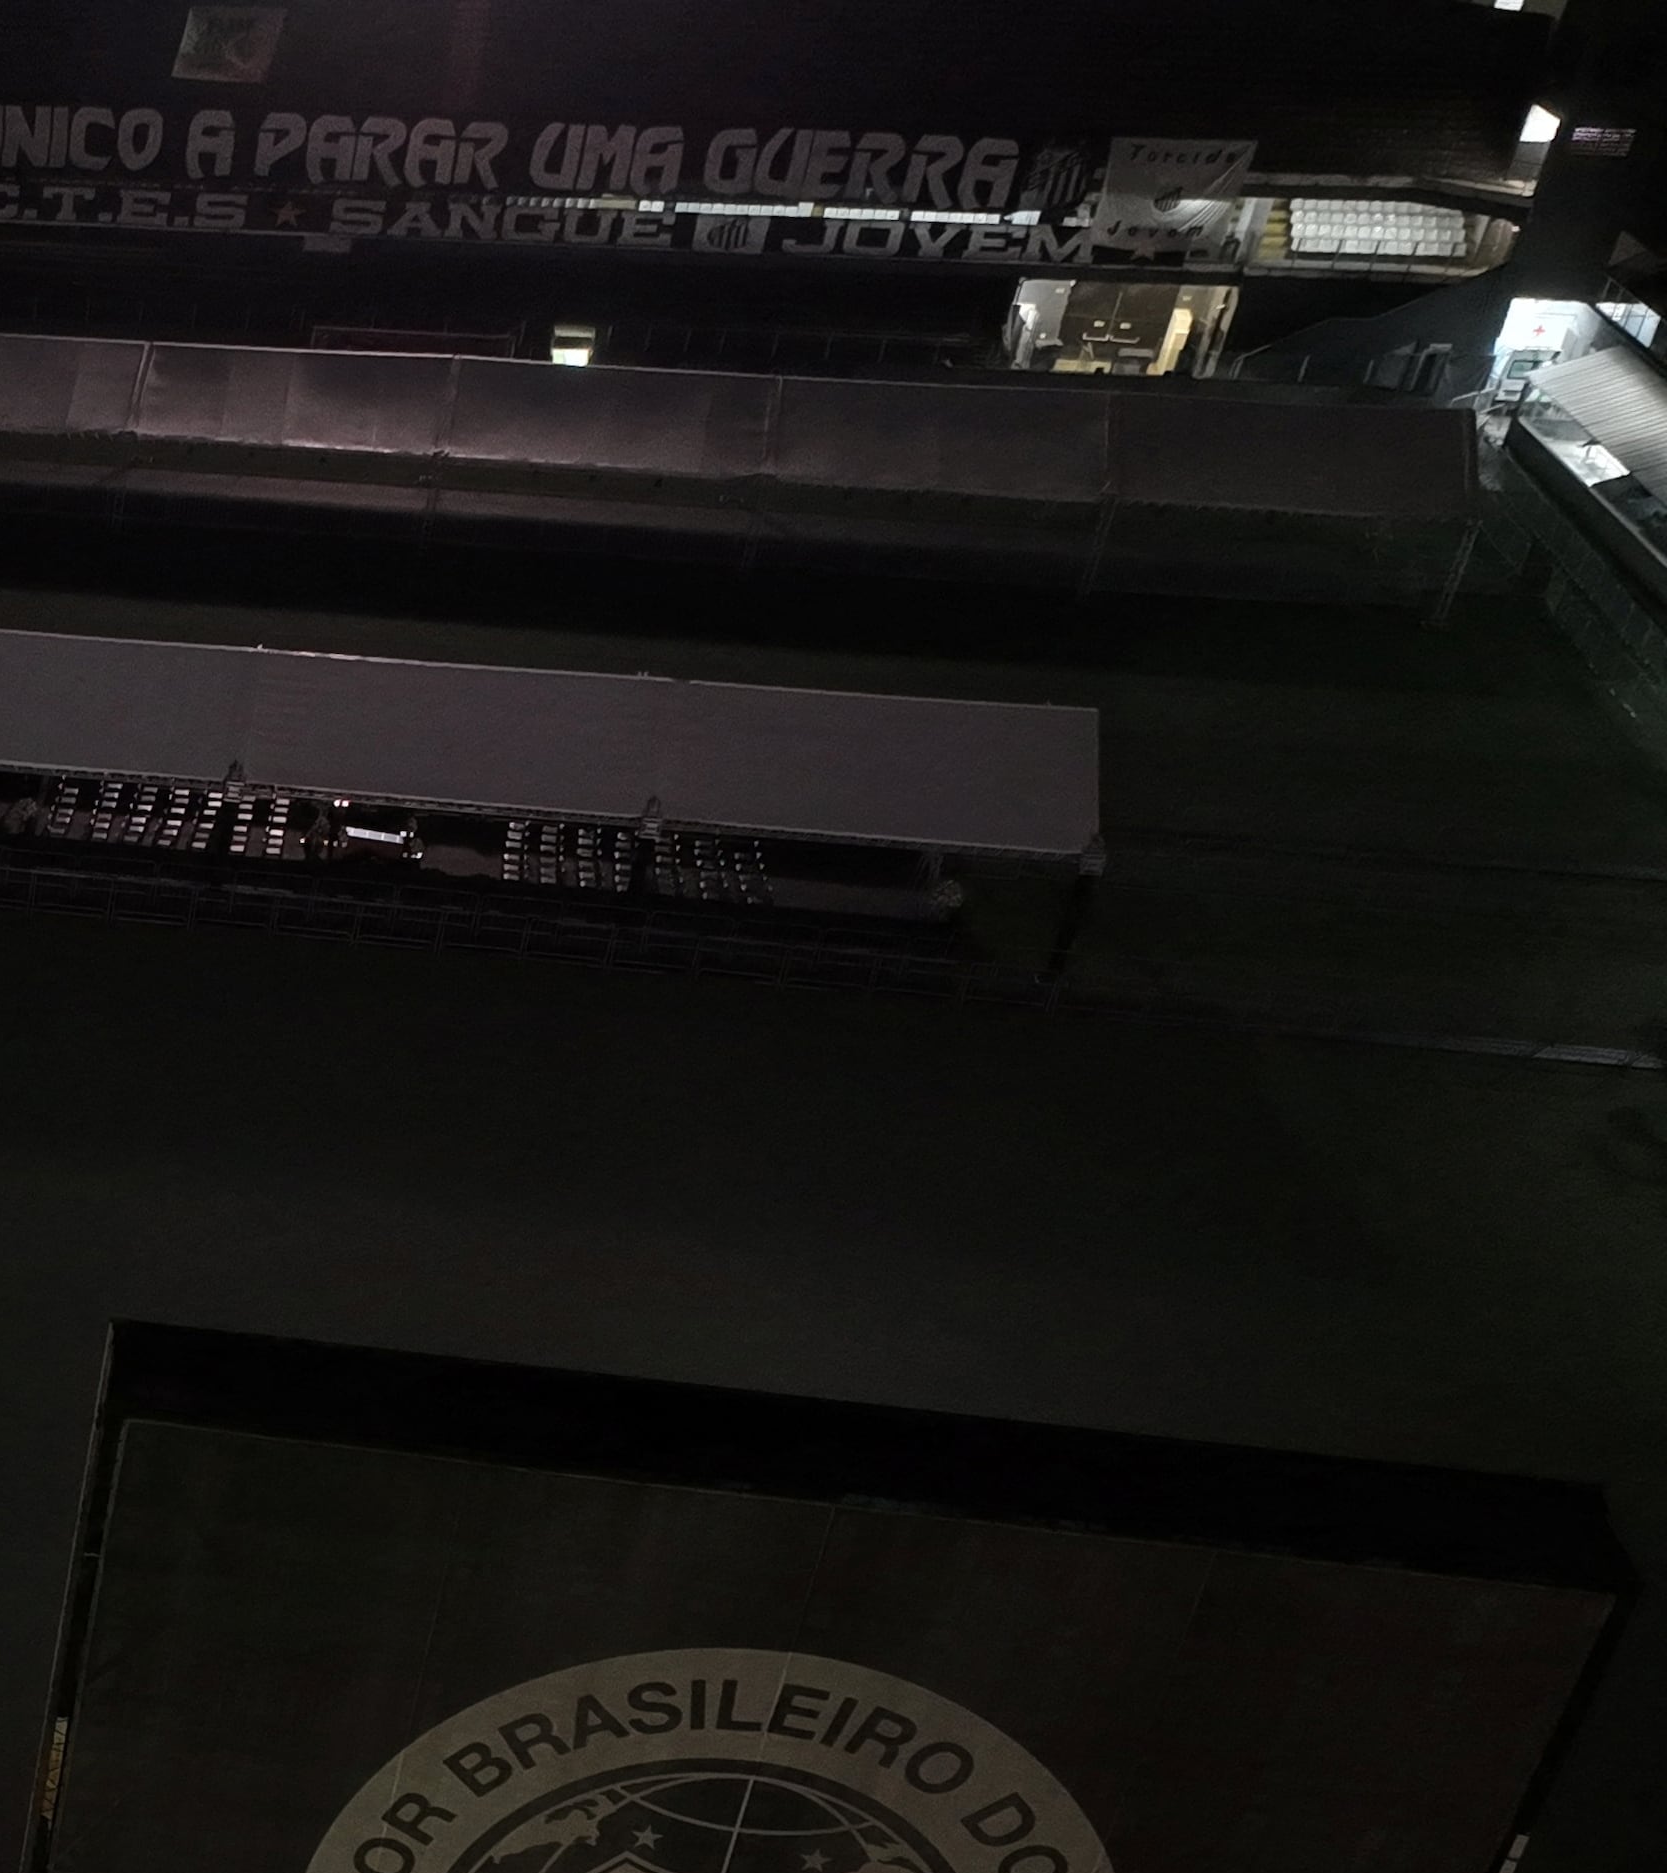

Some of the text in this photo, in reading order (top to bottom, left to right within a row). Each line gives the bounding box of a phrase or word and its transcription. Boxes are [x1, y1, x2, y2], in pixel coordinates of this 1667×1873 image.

[185, 109, 235, 181] A
[253, 111, 510, 190] PARAR
[528, 121, 686, 195] UMA
[703, 126, 1020, 211] GUERRA
[330, 191, 673, 246] SANGUE
[780, 220, 1095, 264] JOVEM
[442, 1679, 976, 1797] BRASILEIRO
